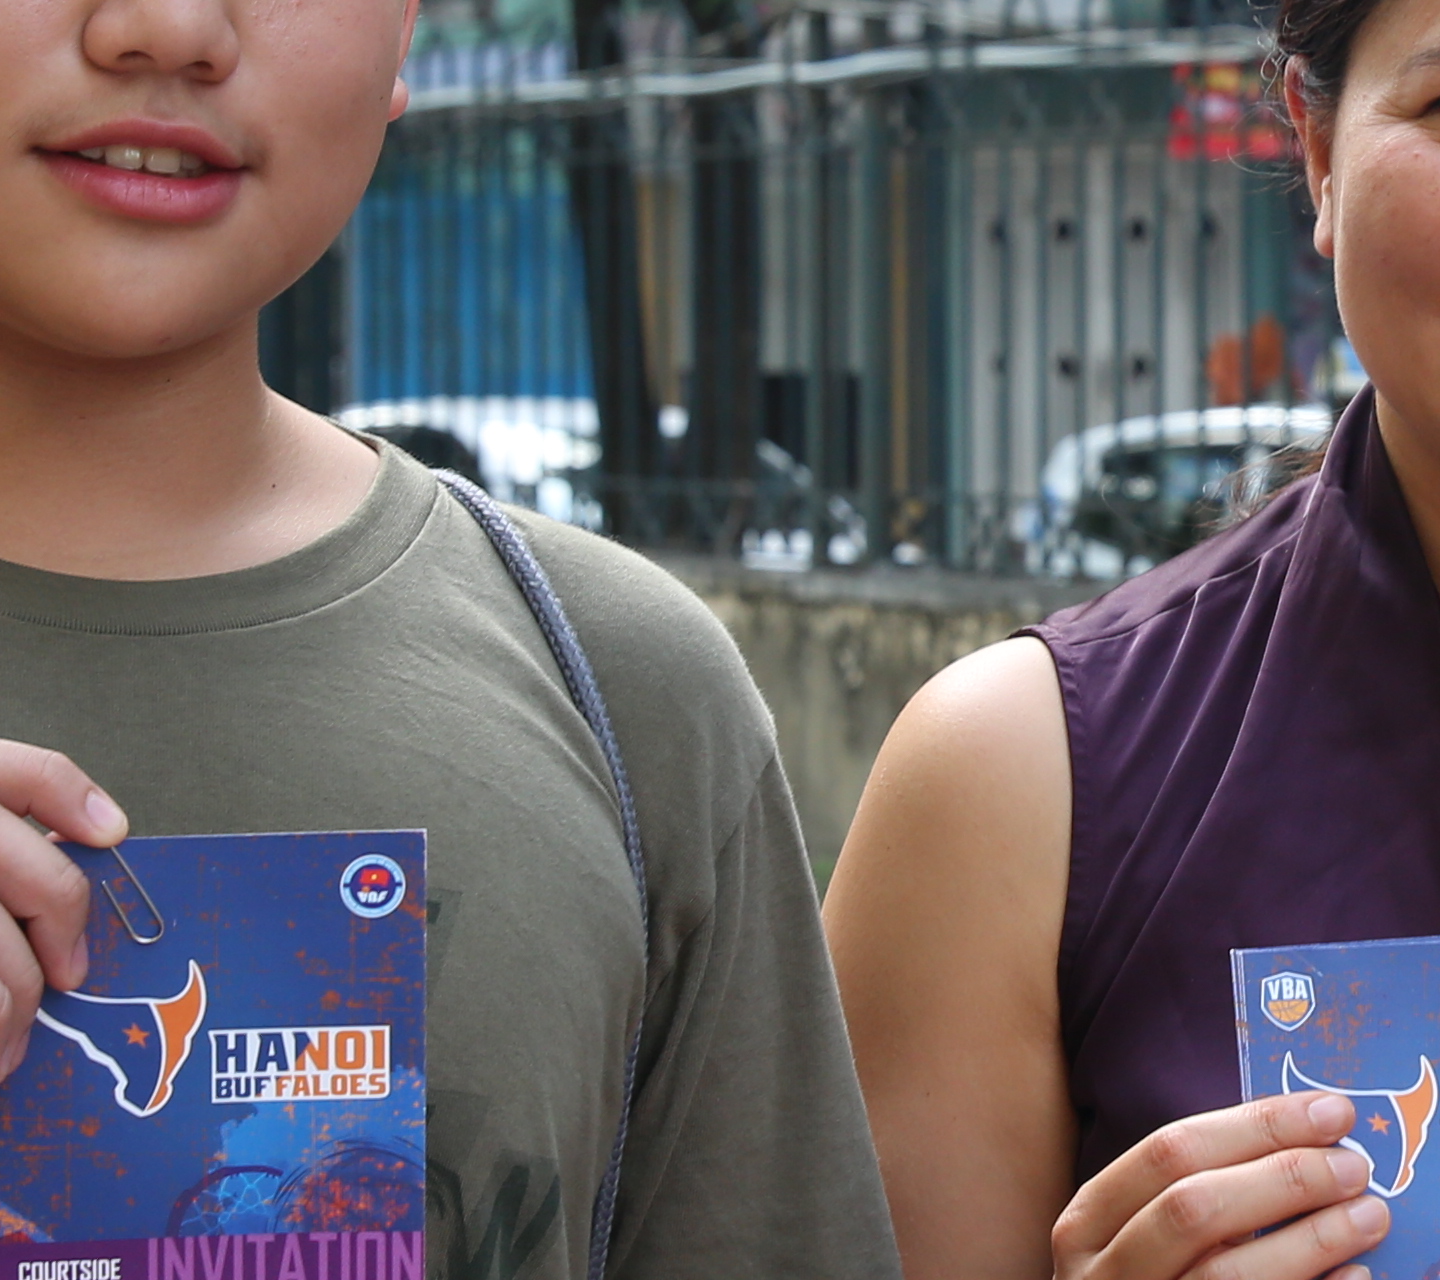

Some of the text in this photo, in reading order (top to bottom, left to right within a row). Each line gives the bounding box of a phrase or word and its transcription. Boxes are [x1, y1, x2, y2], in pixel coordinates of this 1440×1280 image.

[1267, 979, 1308, 1002] VBA
[214, 1029, 387, 1073] HANOI
[215, 1073, 387, 1099] BUFFALOES
